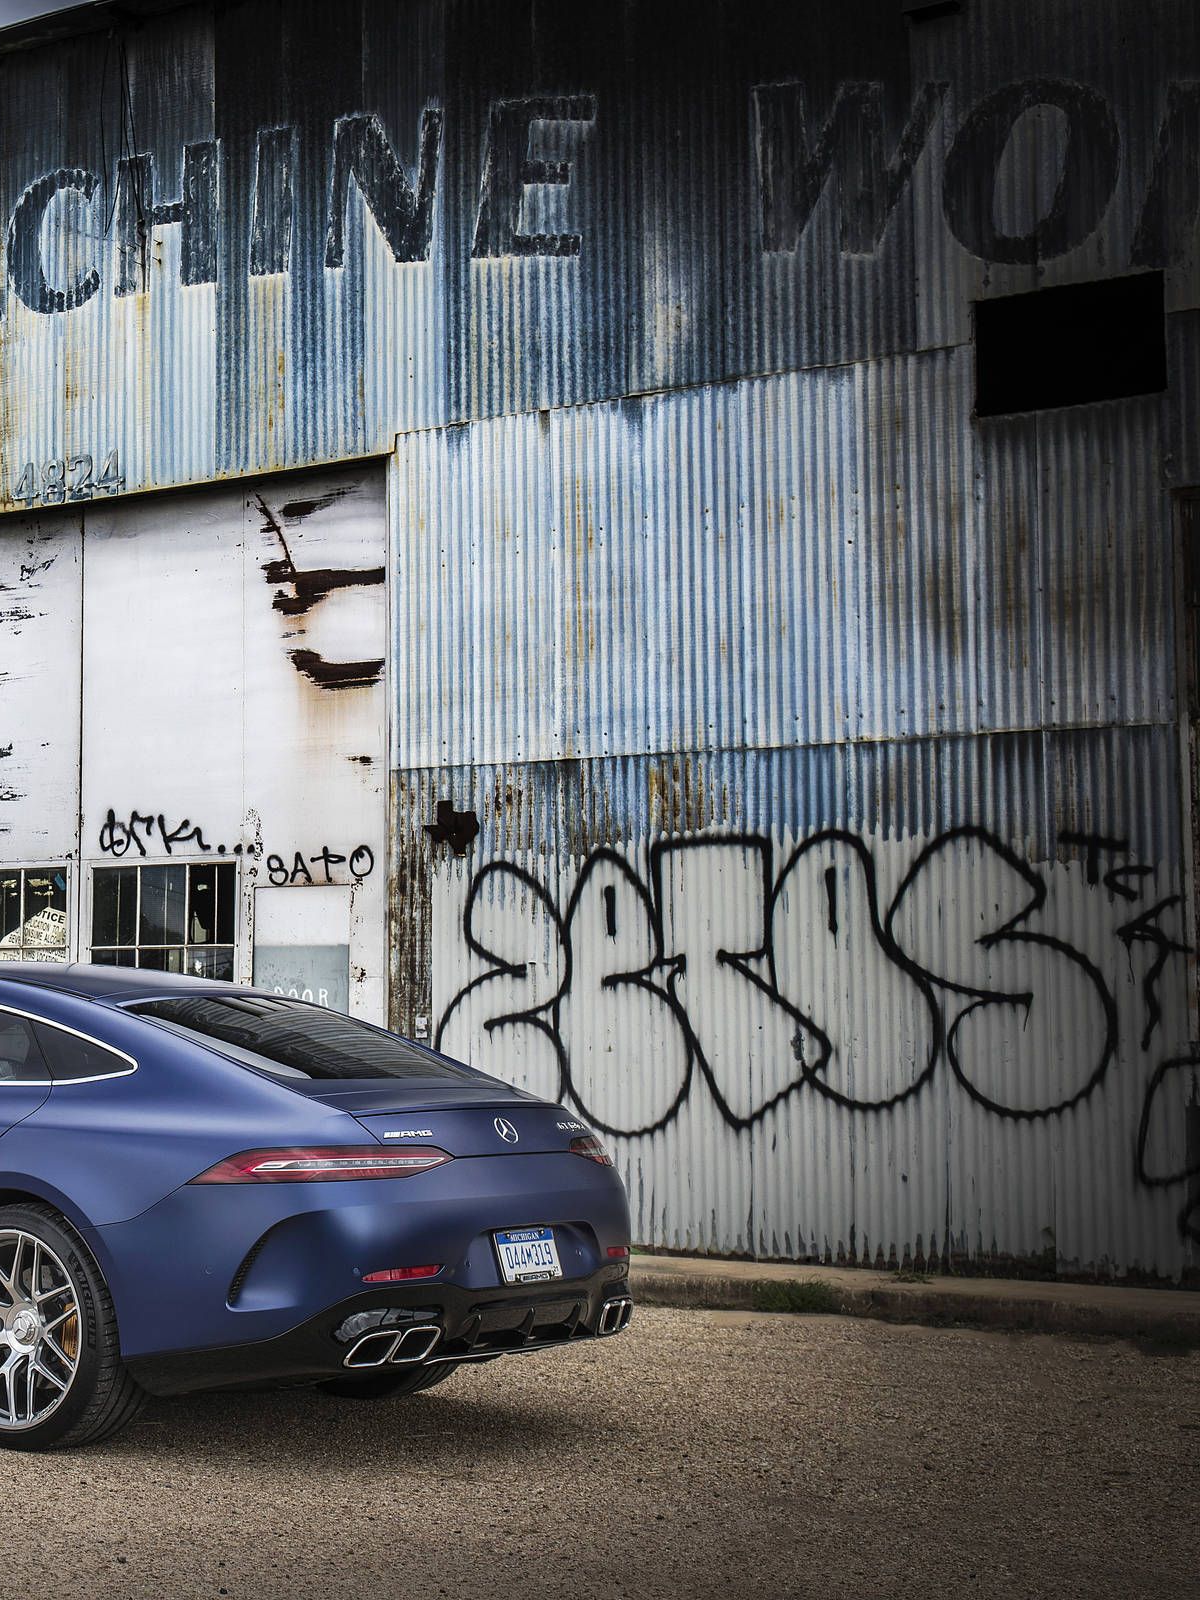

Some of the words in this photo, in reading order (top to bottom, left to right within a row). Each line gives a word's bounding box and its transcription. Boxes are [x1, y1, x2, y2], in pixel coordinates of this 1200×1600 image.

[11, 448, 126, 508] 4824
[401, 1129, 433, 1138] AMG
[510, 1232, 540, 1242] MICHIGAN
[76, 1271, 97, 1347] MICHELIN
